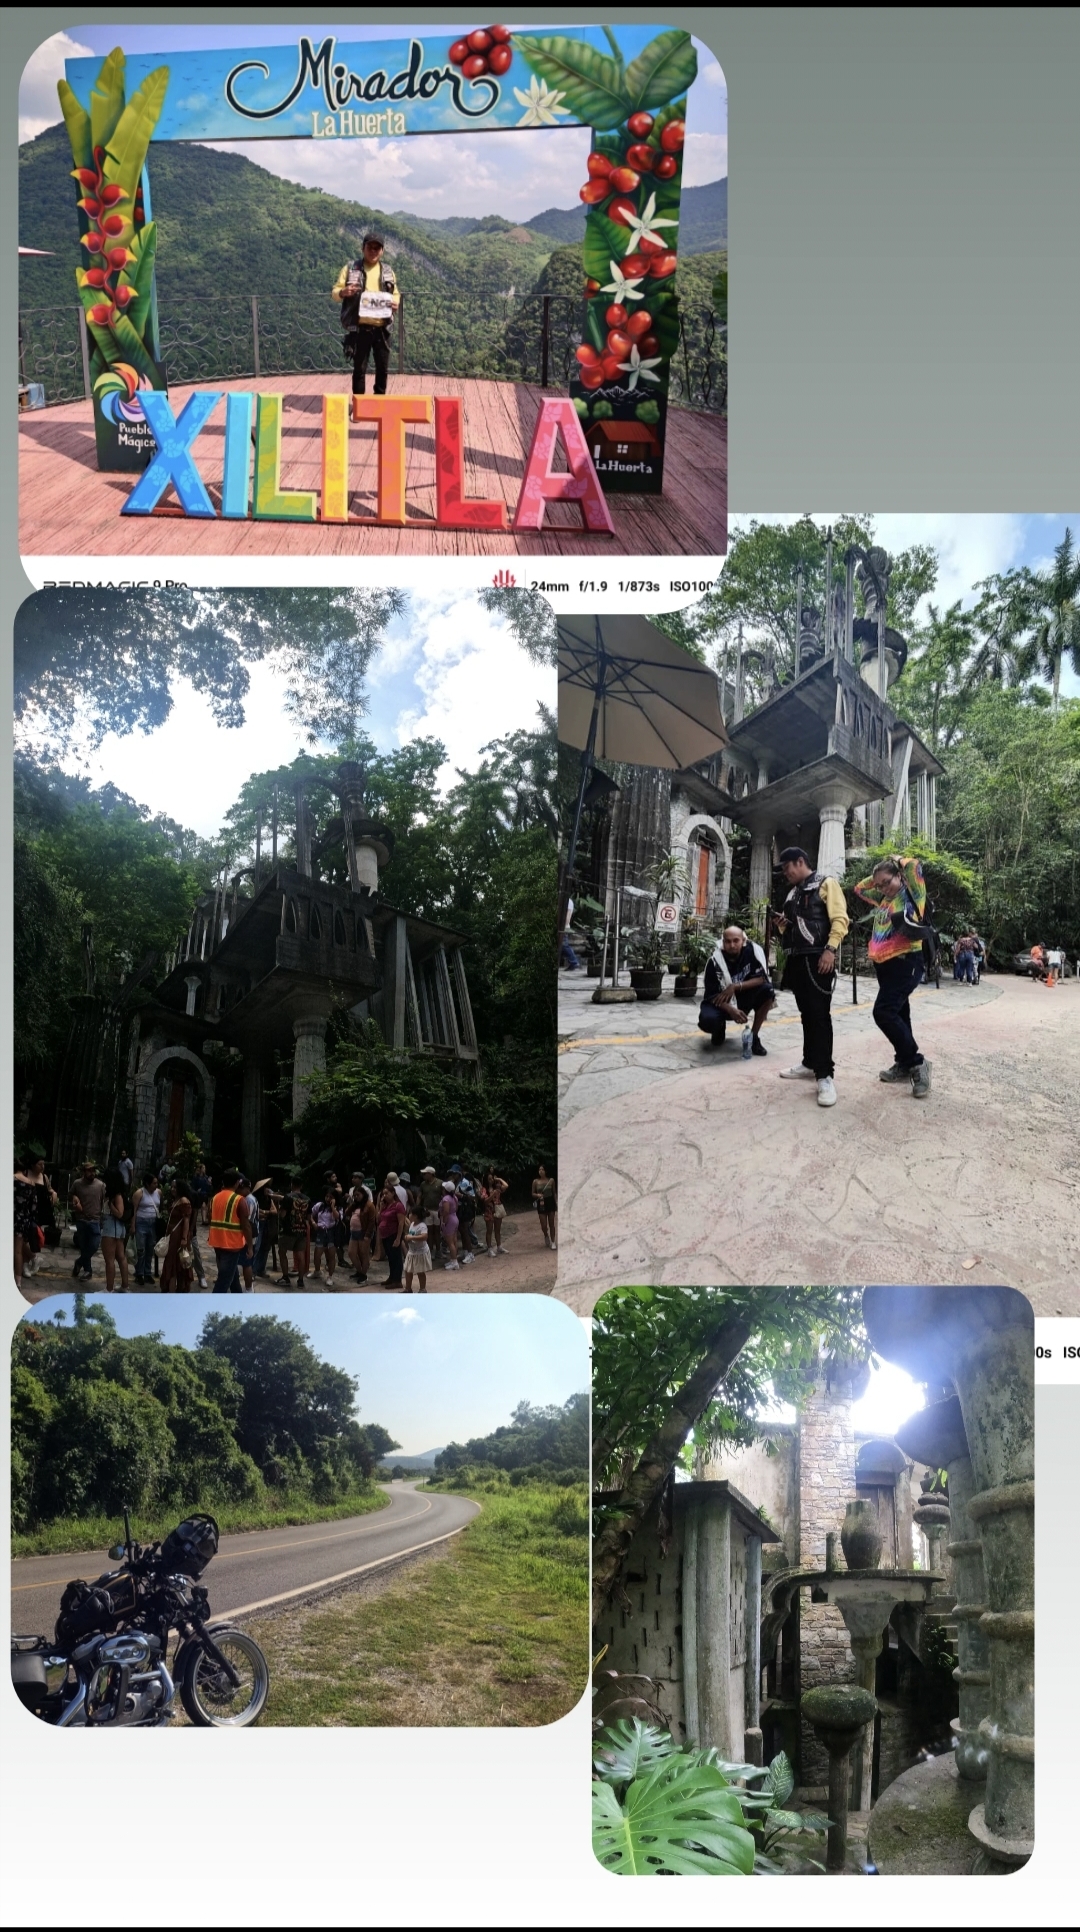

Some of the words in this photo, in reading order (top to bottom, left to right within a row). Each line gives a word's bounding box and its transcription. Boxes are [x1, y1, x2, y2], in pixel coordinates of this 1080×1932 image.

[225, 35, 500, 120] Mirador
[311, 110, 336, 138] La
[338, 109, 406, 136] Huerta
[117, 433, 156, 454] Mágico
[120, 390, 616, 537] XILITLA
[595, 460, 607, 470] La
[607, 460, 653, 474] Huerta
